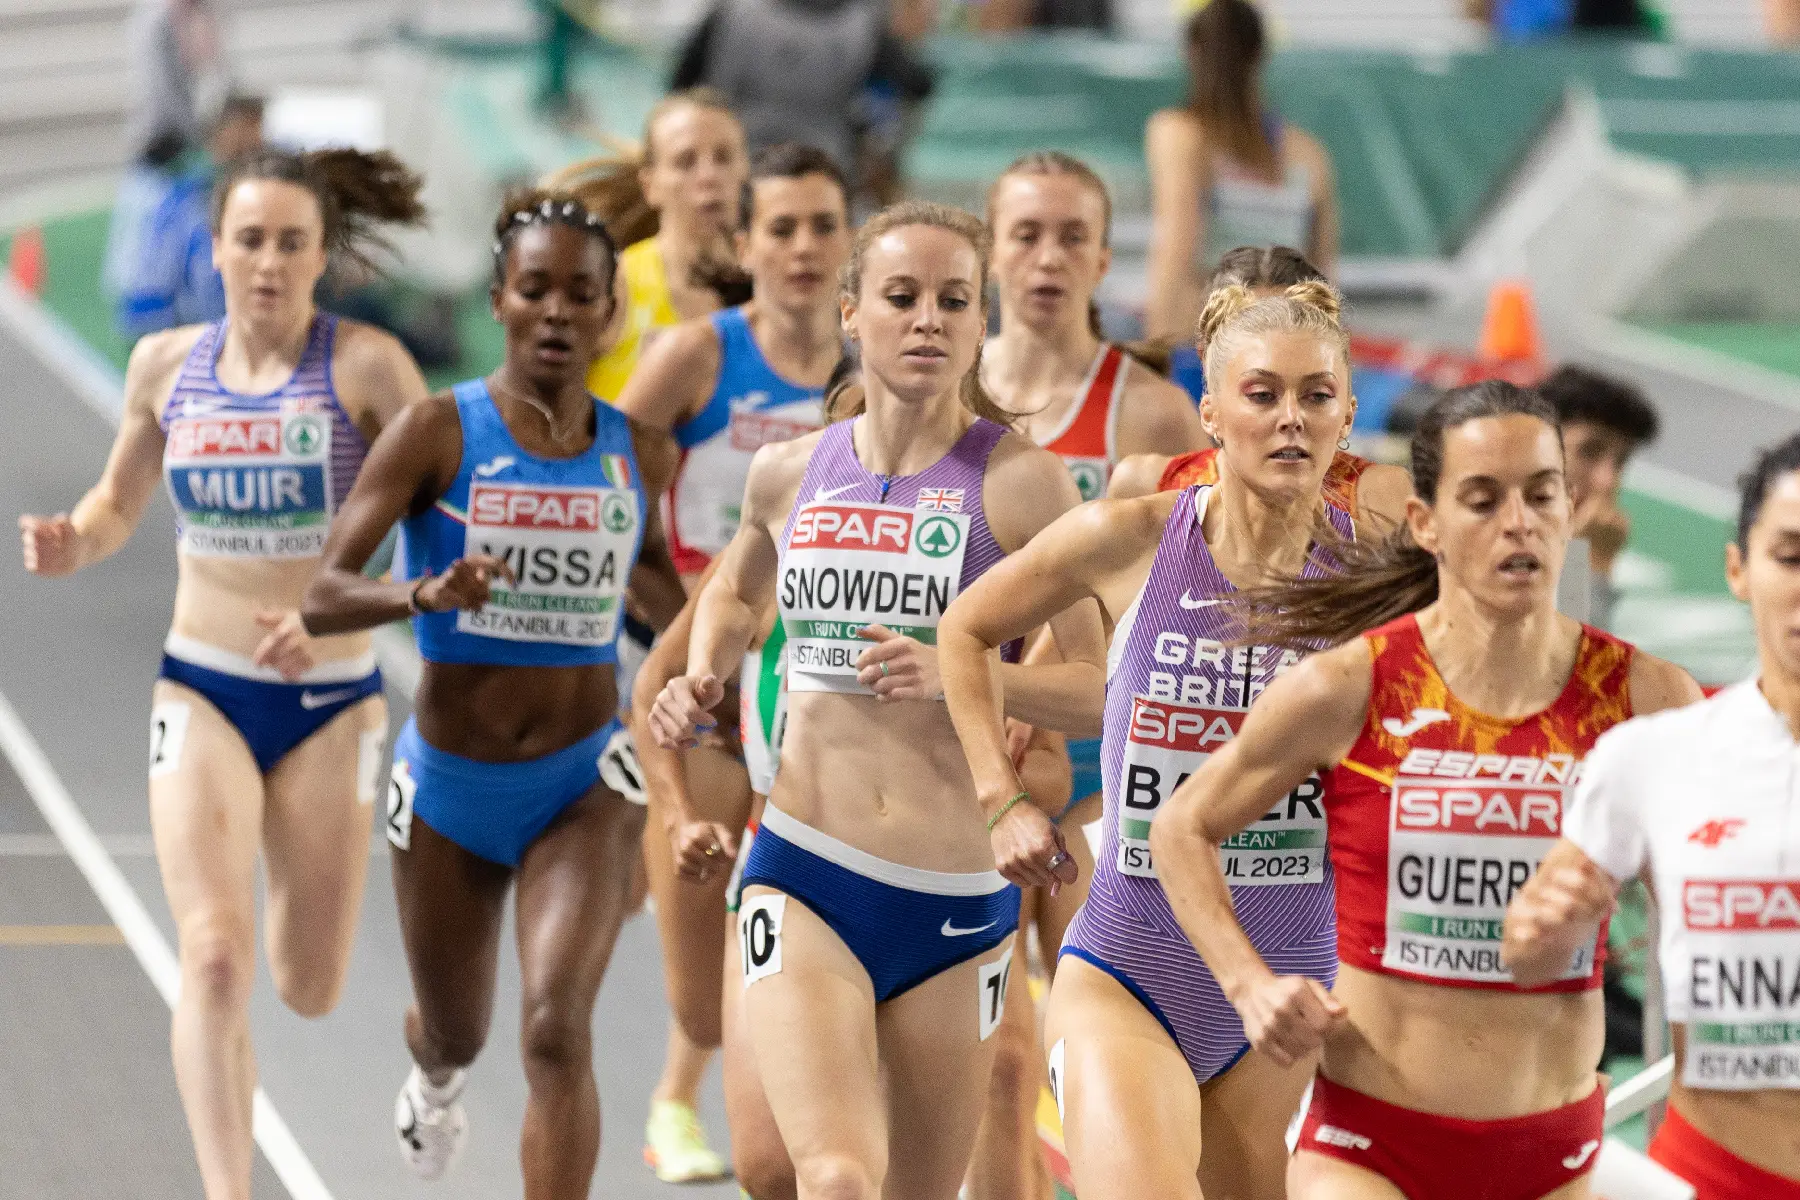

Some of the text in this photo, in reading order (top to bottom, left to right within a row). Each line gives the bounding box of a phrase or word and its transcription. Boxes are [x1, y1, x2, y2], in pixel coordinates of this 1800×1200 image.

[171, 421, 278, 456] SPAR
[188, 470, 305, 512] MUIR
[475, 491, 597, 528] SPAR
[792, 512, 908, 547] SPAR
[782, 567, 950, 616] SNOWDEN
[815, 622, 842, 638] RUN
[797, 645, 862, 668] ISTANBU
[1133, 704, 1240, 746] SPA
[1400, 789, 1559, 833] SPAR
[1251, 855, 1310, 878] 2023
[742, 907, 776, 976] 10
[1444, 919, 1490, 940] RUN
